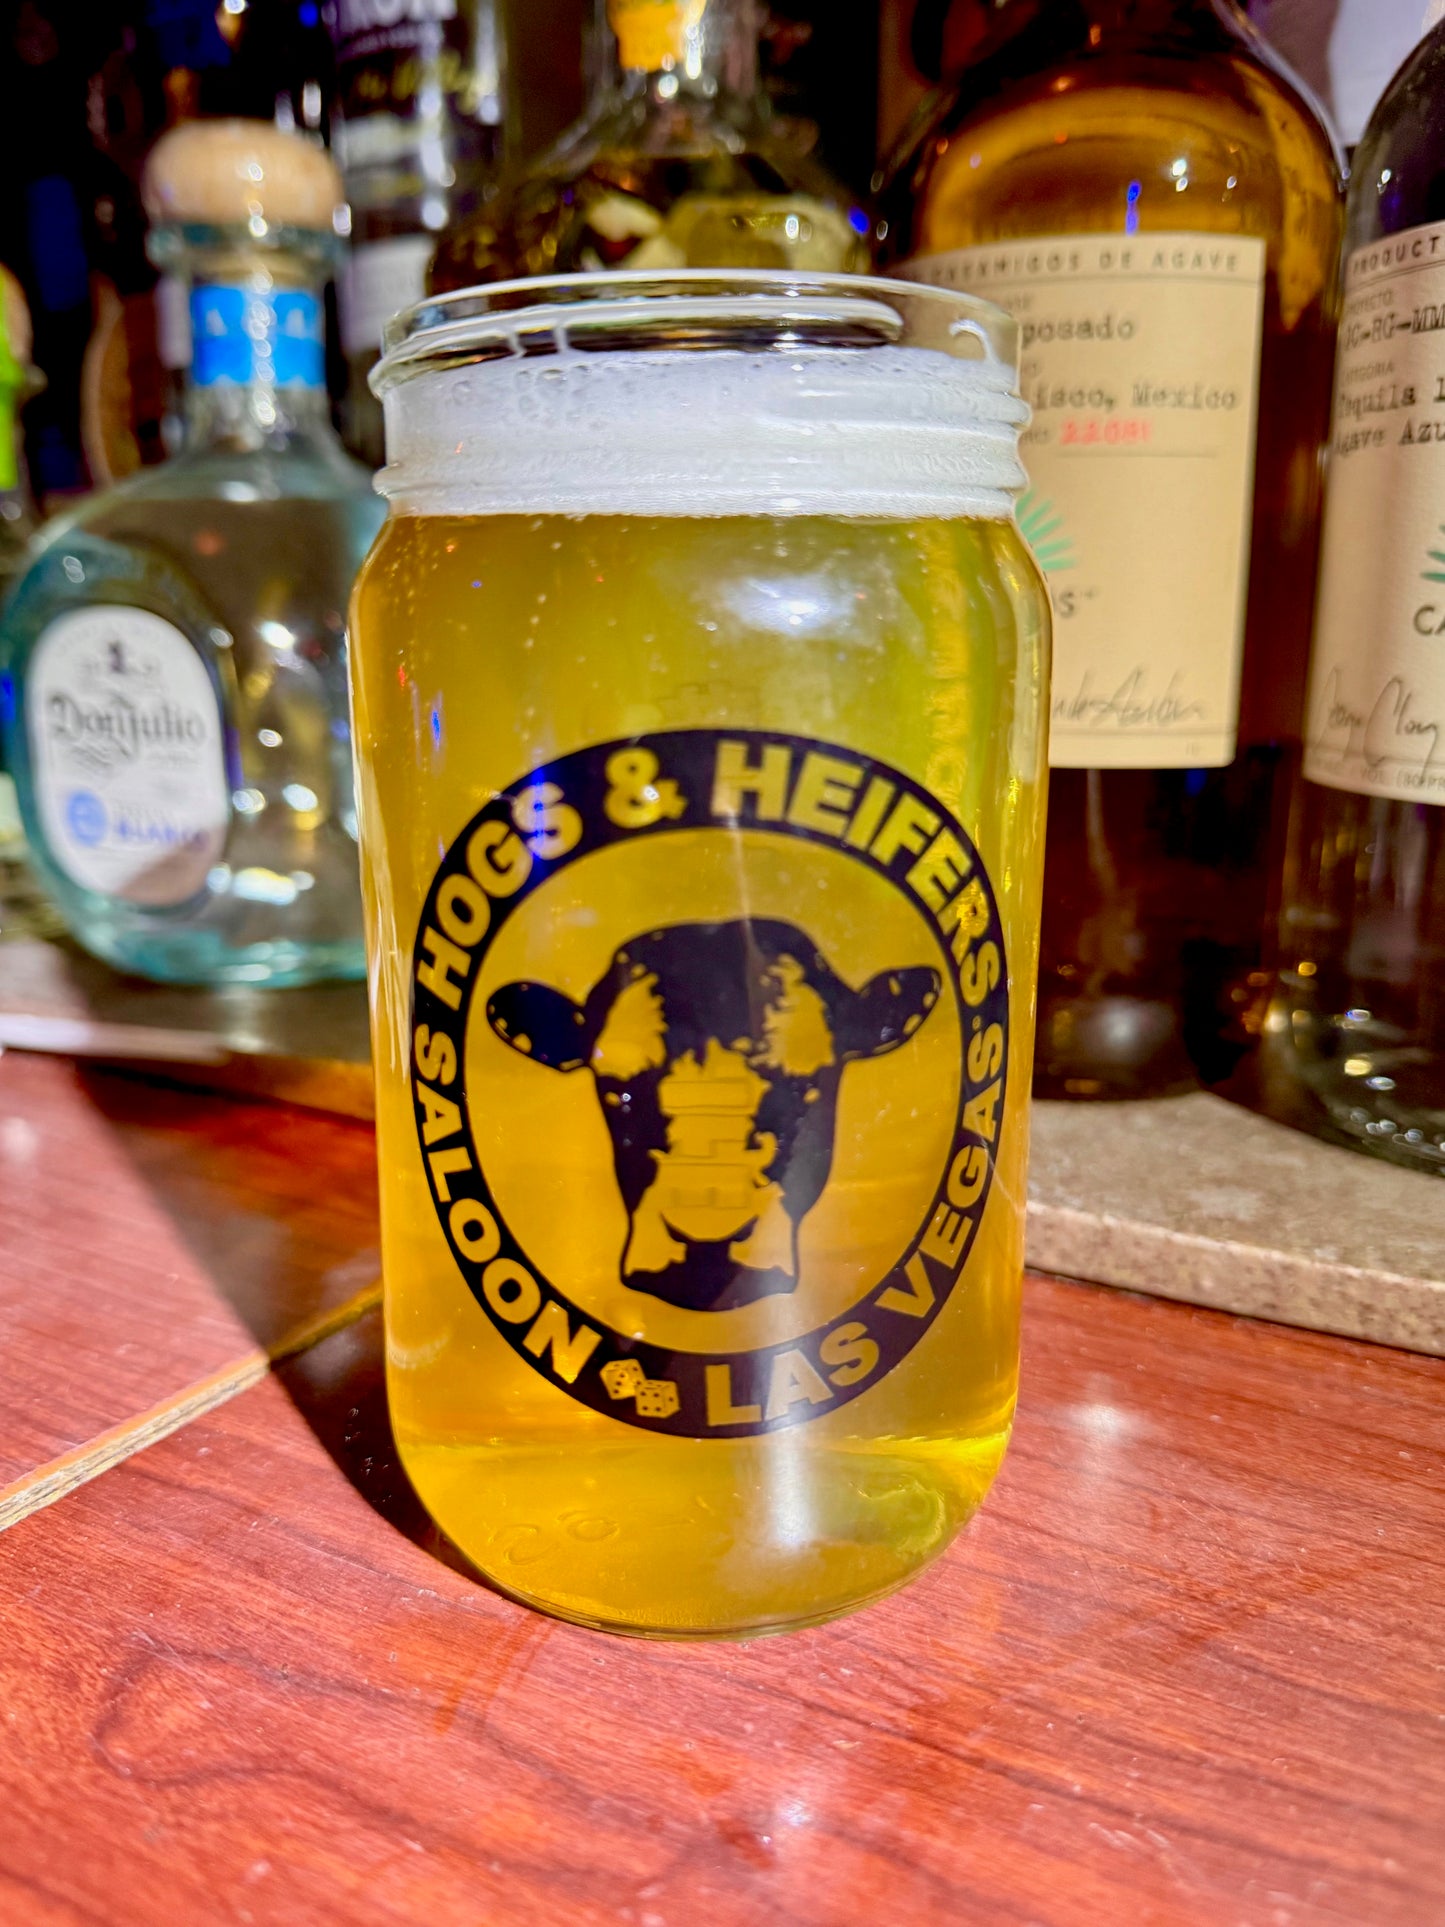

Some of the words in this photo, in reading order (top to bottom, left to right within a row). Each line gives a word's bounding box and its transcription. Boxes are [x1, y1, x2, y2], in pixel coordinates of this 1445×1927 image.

[1099, 251, 1132, 271] DE
[1151, 251, 1238, 272] AGAVE
[416, 781, 584, 1012] HOGS
[603, 747, 688, 830] &
[710, 738, 1000, 1007] HEIFERS
[414, 1022, 604, 1385] SALOON
[704, 1320, 880, 1428] LAS
[873, 1020, 1003, 1320] VEGAS
